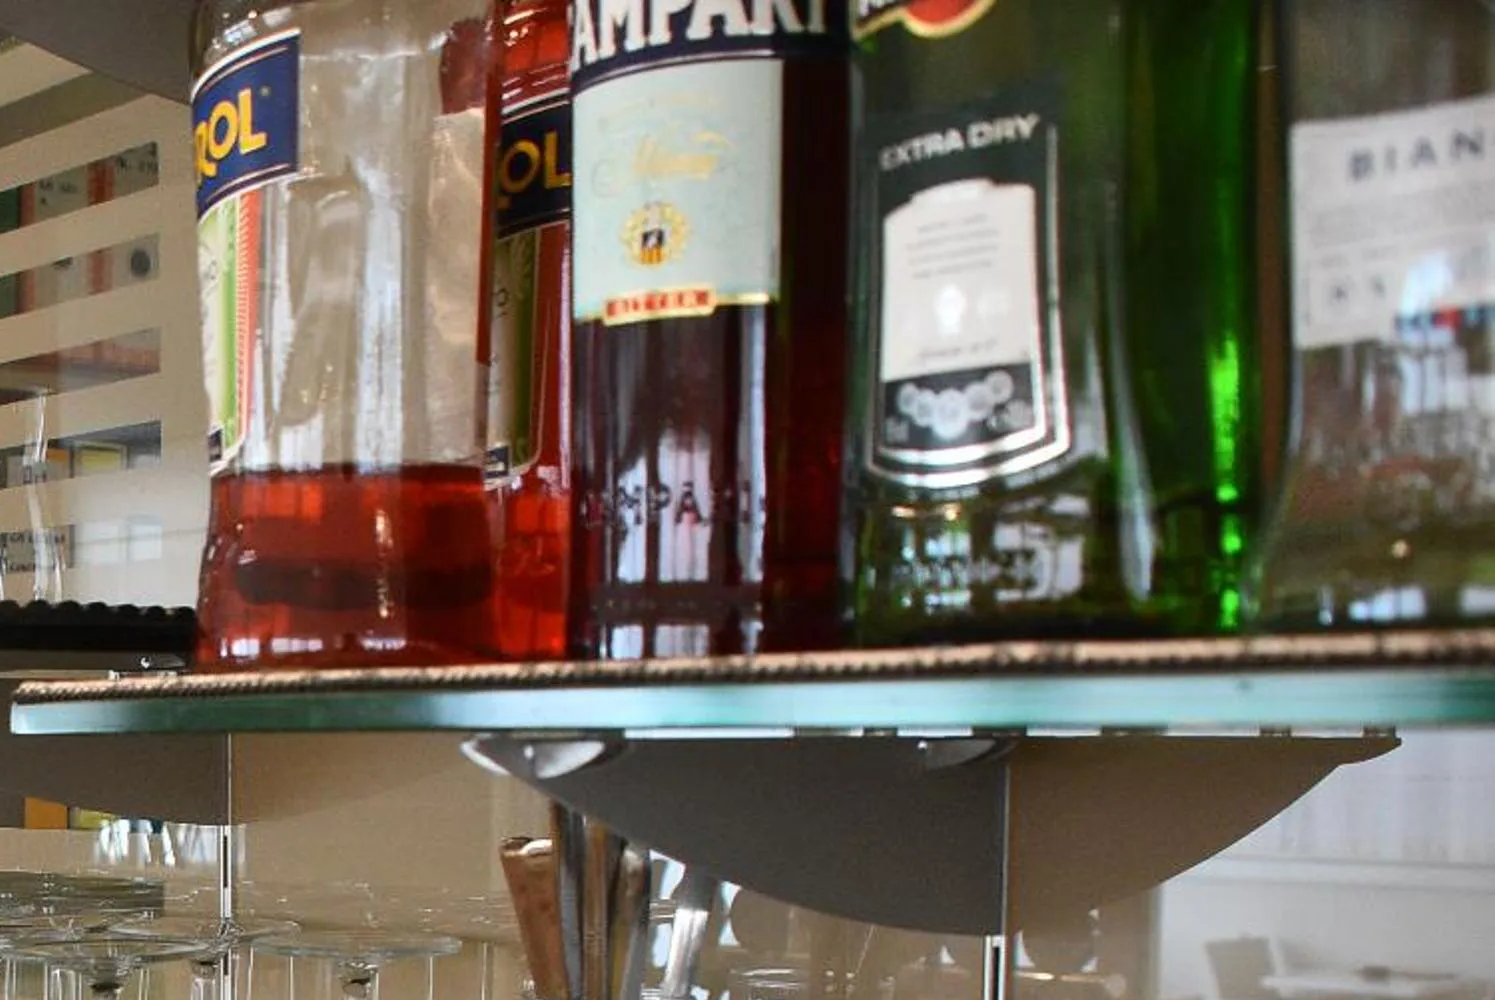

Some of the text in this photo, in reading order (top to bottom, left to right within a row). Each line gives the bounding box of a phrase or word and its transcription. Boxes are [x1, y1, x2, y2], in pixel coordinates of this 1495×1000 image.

[567, 0, 825, 72] AMPARI
[494, 131, 572, 210] OL
[878, 112, 1041, 171] EXTRA DRY
